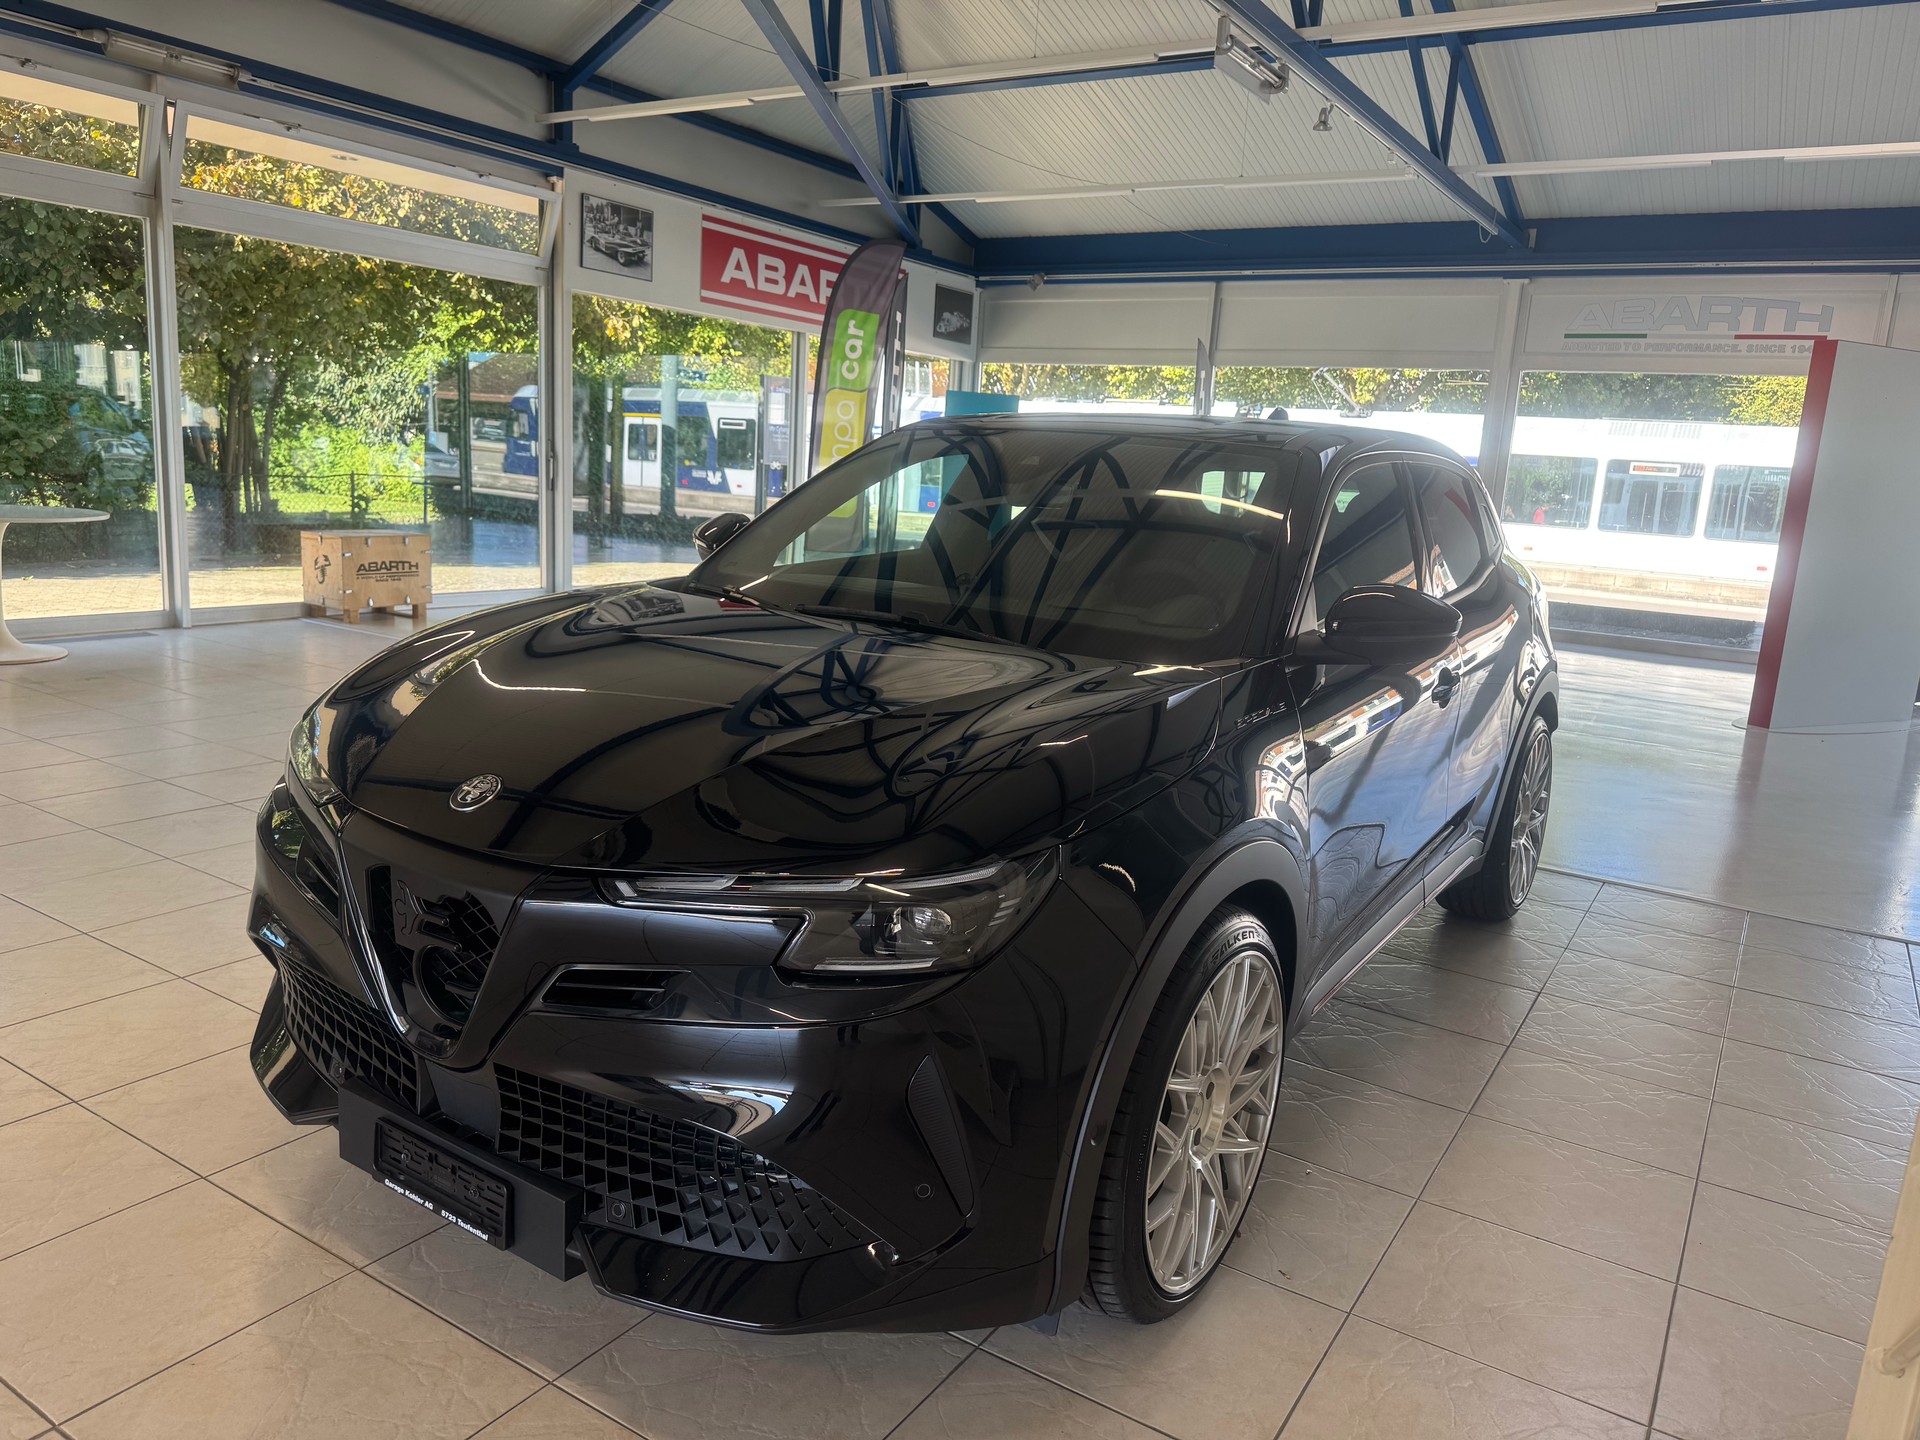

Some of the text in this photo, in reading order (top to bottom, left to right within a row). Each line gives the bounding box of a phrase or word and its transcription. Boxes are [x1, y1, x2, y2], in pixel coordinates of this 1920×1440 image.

[1565, 296, 1835, 332] ABARTH
[841, 319, 865, 380] car
[1623, 342, 1642, 352] TO
[1746, 343, 1786, 353] SINCE
[1790, 344, 1813, 354] 194
[356, 560, 419, 572] ABARTH
[384, 1178, 489, 1241] Garage Kohler AG 5723 Teufenthal
